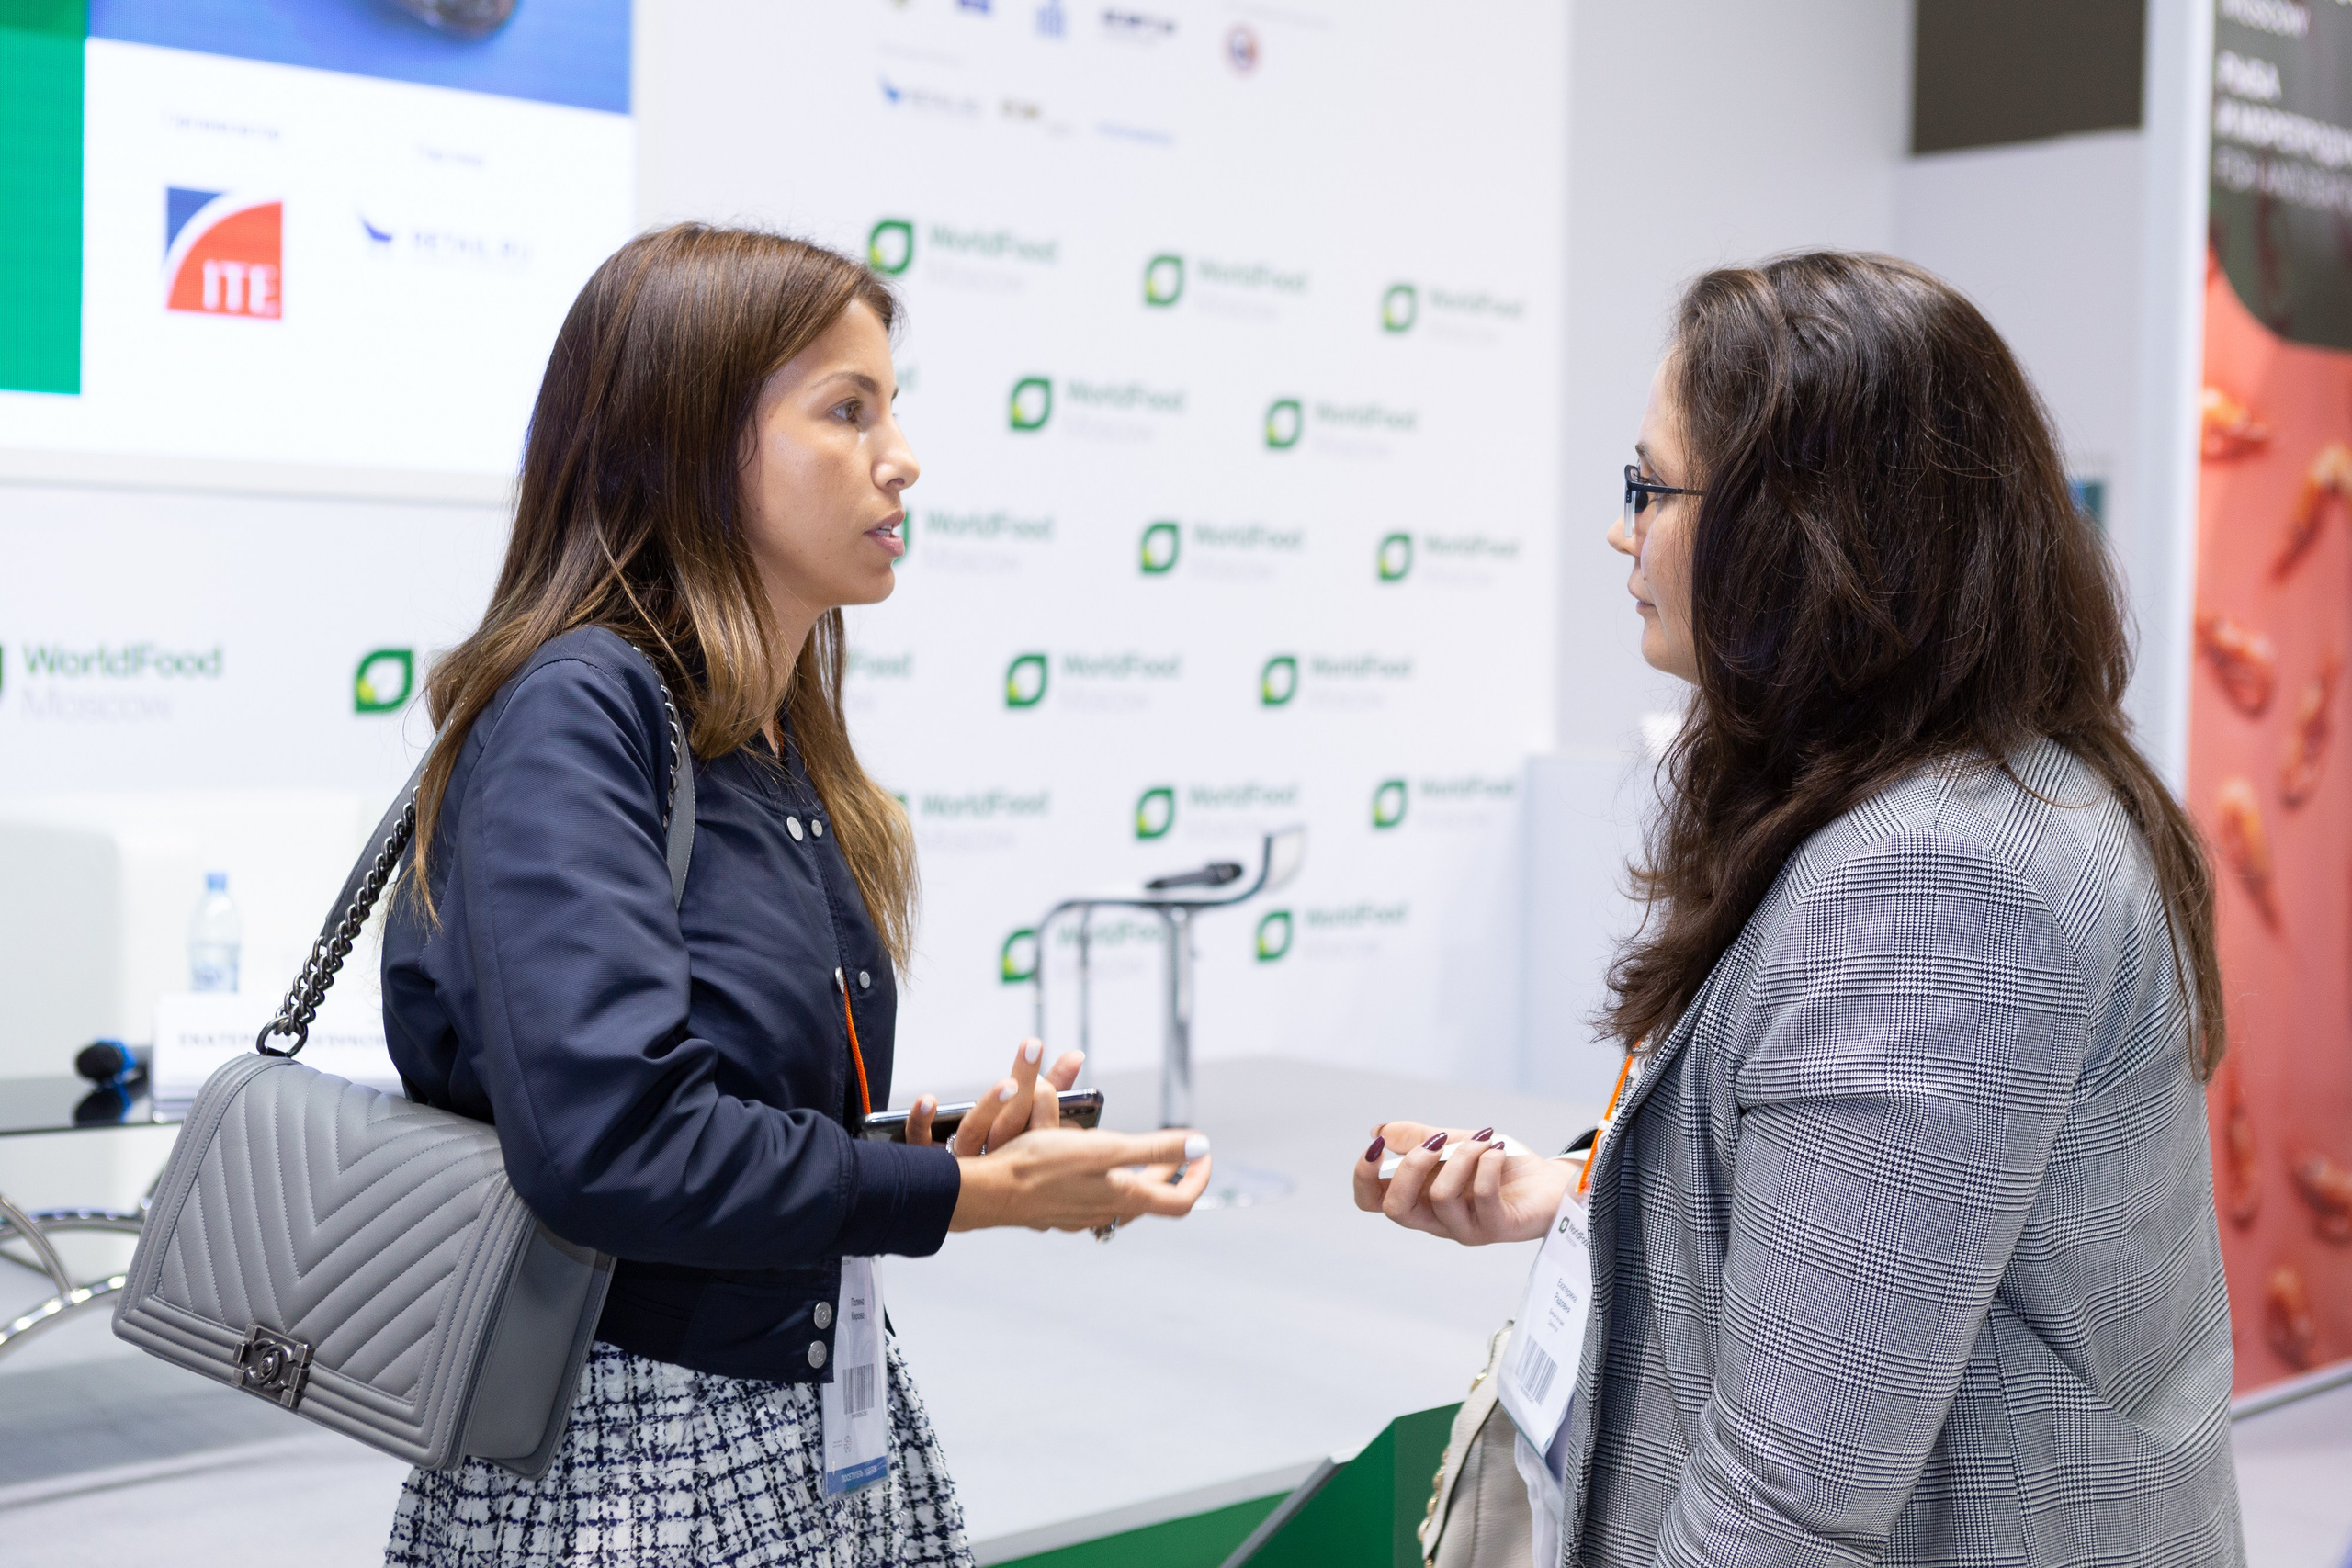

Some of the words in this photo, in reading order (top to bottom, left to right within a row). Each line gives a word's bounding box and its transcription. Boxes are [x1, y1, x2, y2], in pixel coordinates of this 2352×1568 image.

[202, 258, 281, 315] ITE
[924, 510, 1055, 542] WorldFood
[1192, 523, 1304, 551] WorldFood
[22, 642, 224, 678] WorldFood
[1060, 651, 1182, 680] WorldFood
[920, 789, 1050, 818] WorldFood
